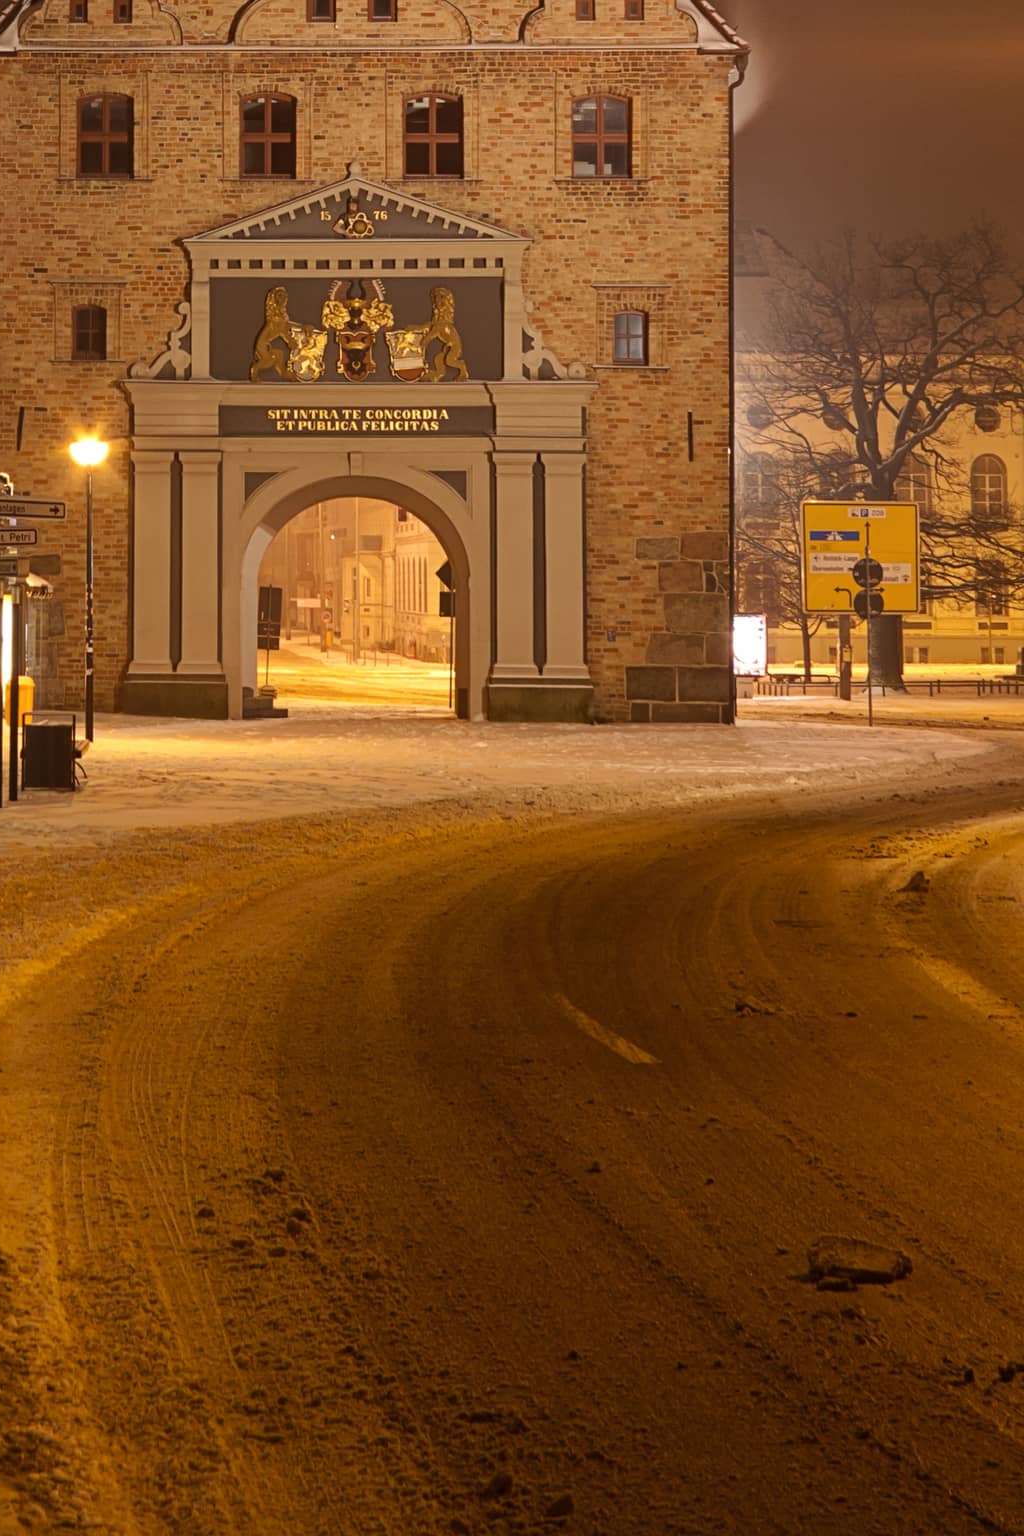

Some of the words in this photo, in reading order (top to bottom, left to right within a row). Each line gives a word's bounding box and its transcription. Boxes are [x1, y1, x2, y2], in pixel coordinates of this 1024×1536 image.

[320, 210, 332, 221] 15
[373, 210, 388, 221] 76
[267, 409, 291, 420] SIT
[293, 409, 339, 420] INTRA
[342, 409, 362, 420] TE
[365, 409, 449, 420] CONCORDIA
[276, 420, 296, 431] ET
[298, 420, 358, 431] PUBLICA
[362, 420, 439, 431] FELICITAS
[9, 532, 31, 542] Petri
